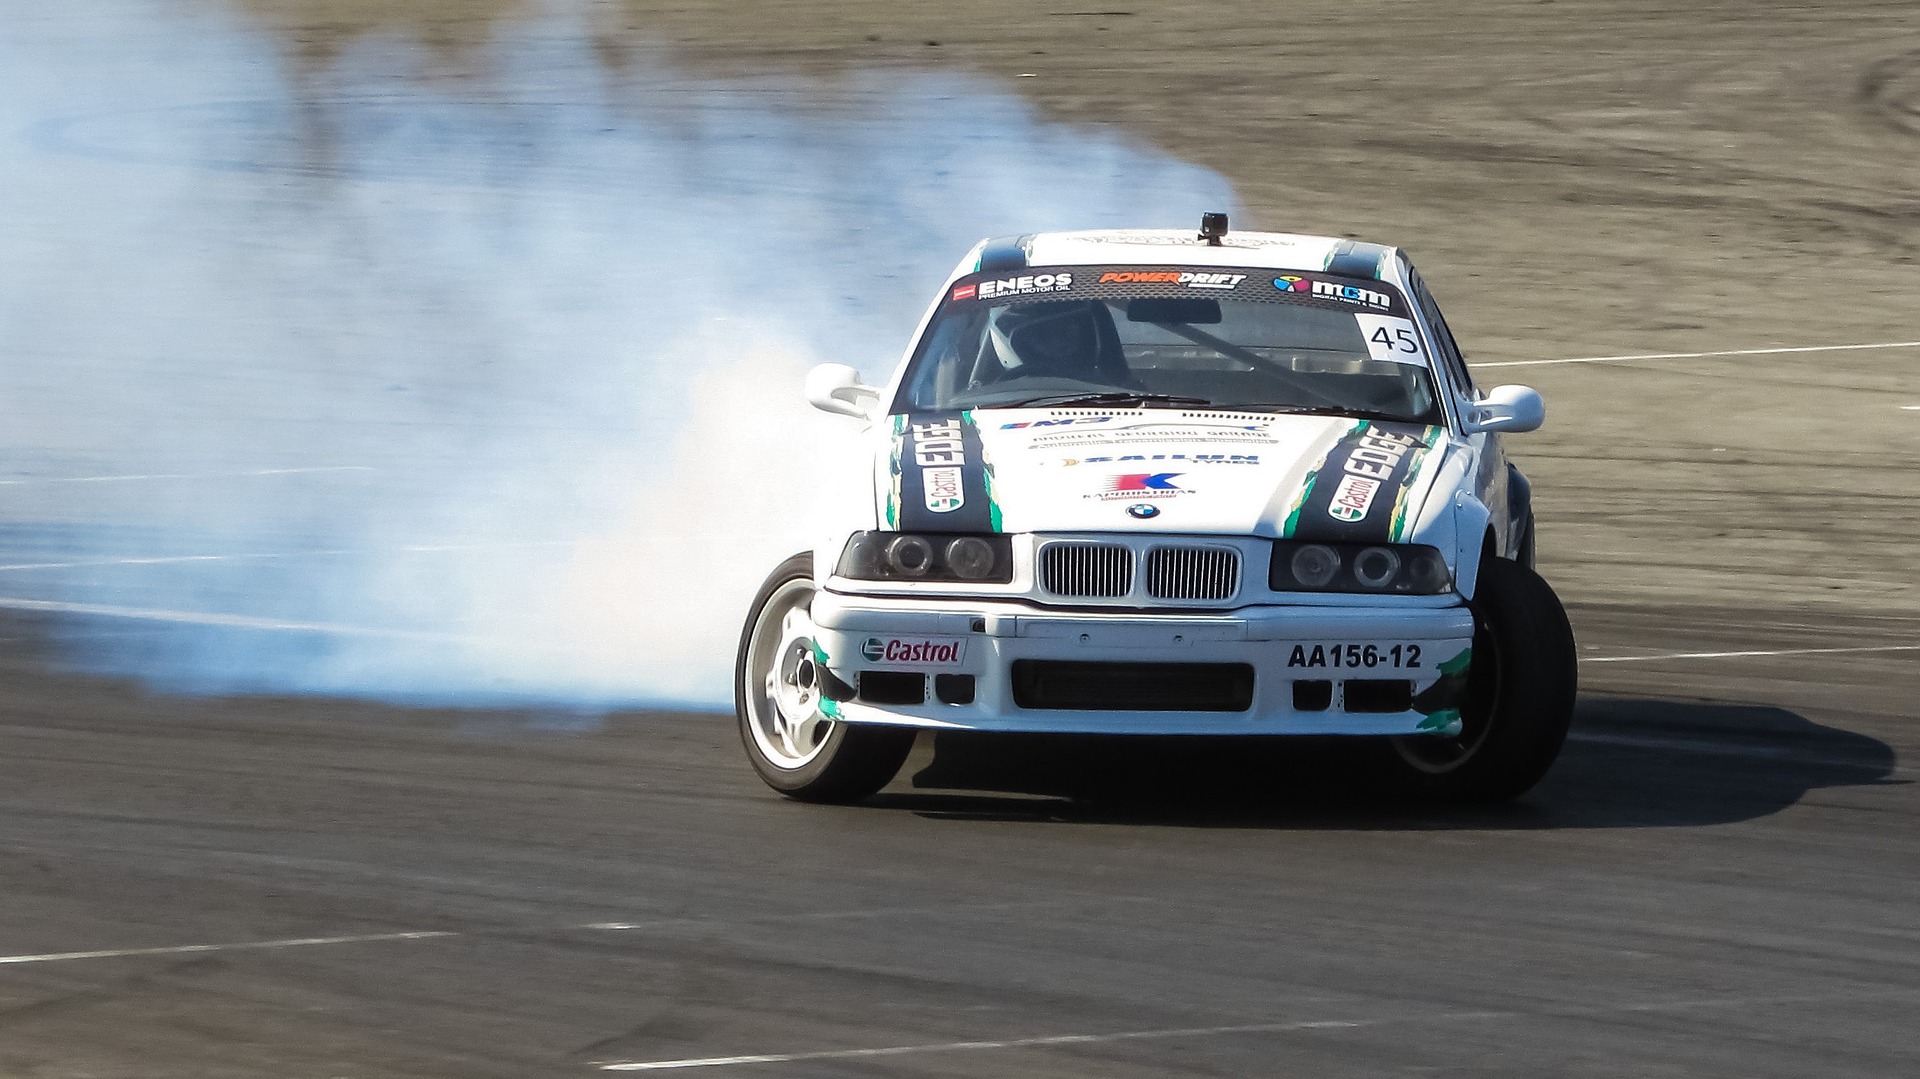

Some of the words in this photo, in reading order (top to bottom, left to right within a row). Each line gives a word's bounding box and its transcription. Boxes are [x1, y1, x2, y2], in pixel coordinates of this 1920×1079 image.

[978, 273, 1072, 295] ENEOS
[1098, 271, 1248, 286] POWERDRIFT
[978, 289, 1020, 300] PREMIUM
[1021, 286, 1054, 295] MOTOR
[1055, 284, 1071, 292] OIL
[1371, 326, 1419, 355] 45
[1031, 416, 1113, 429] M3
[912, 418, 966, 466] EDGE
[1343, 424, 1416, 481] EDGE
[1084, 454, 1259, 463] SAILUN
[930, 469, 958, 498] Castrol
[1337, 477, 1375, 509] Castrol
[885, 639, 960, 662] Castrol
[1287, 643, 1422, 668] AA156-12
